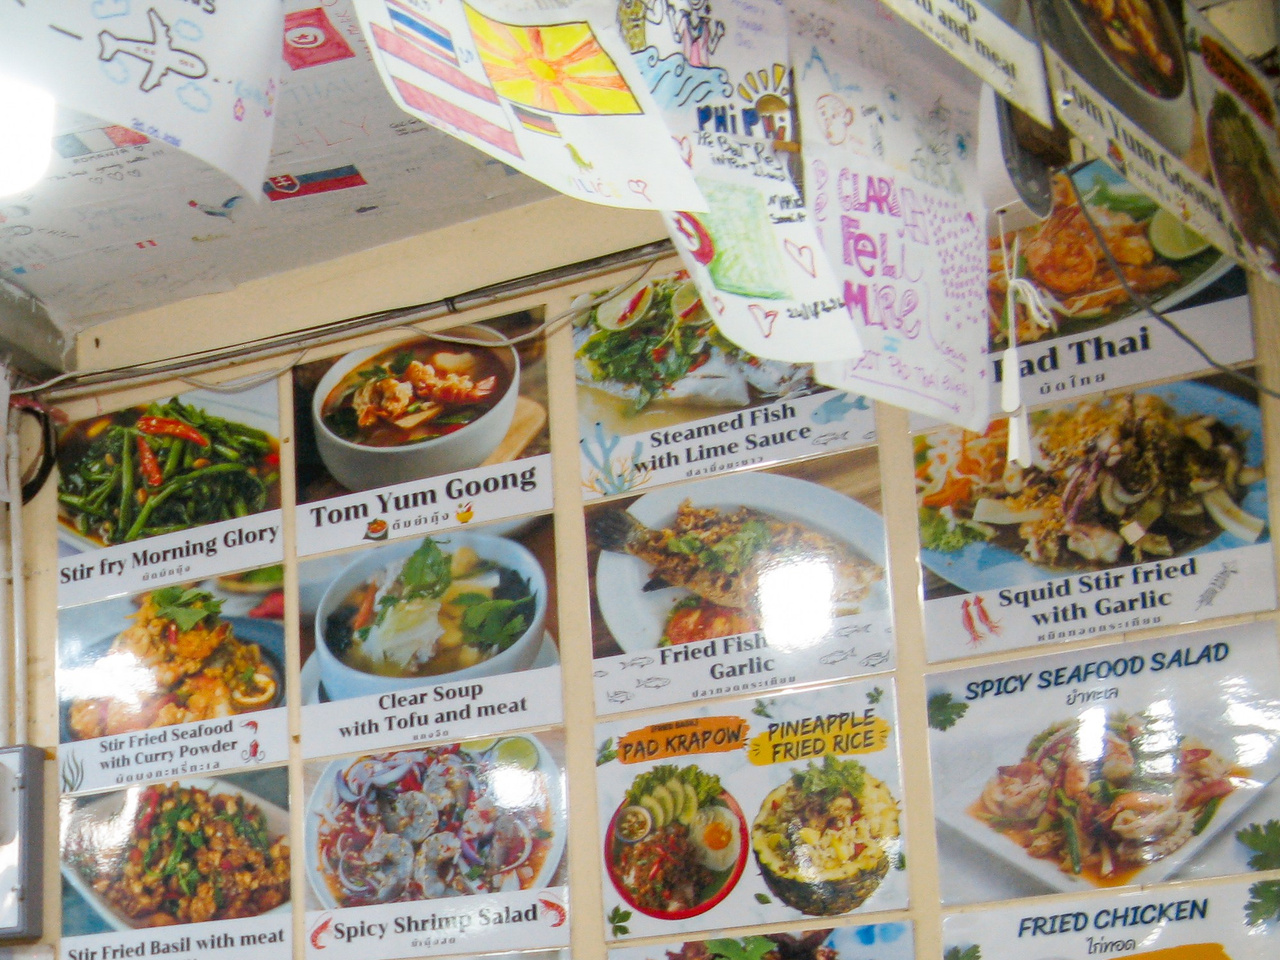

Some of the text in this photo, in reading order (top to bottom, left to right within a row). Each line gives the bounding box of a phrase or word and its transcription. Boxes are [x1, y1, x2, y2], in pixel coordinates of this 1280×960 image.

[974, 38, 1016, 79] meat
[1068, 325, 1152, 366] Thai
[650, 402, 797, 448] Steamed Fish
[634, 423, 813, 475] with Lime Sauce
[310, 465, 538, 528] Tom Yum Goong
[60, 523, 280, 584] Stir fry Morning Glory
[998, 557, 1198, 608] Squid Stir fried
[1031, 589, 1172, 627] with Garlic
[659, 632, 769, 668] Fried Fish
[710, 655, 776, 682] Garlic
[965, 642, 1230, 702] SPICY SEAFOOD SALAD
[378, 682, 484, 711] Clear Soup
[1066, 686, 1119, 707] ยำทะเล
[99, 719, 234, 754] Stir Fried Seafood
[338, 696, 528, 740] with Tofu and meat
[768, 708, 876, 741] PINEAPPLE
[100, 738, 238, 770] with Curry Powder
[622, 724, 744, 759] PAD KRAPOW
[771, 730, 876, 762] FRIED RICE
[334, 903, 539, 943] Spicy Shrimp Salad
[1018, 898, 1210, 939] FRIED CHICKEN
[102, 941, 145, 960] Fried
[150, 936, 191, 955] Basil
[196, 930, 235, 950] with
[240, 927, 285, 947] meat
[1086, 936, 1137, 955] ไก่ทอด
